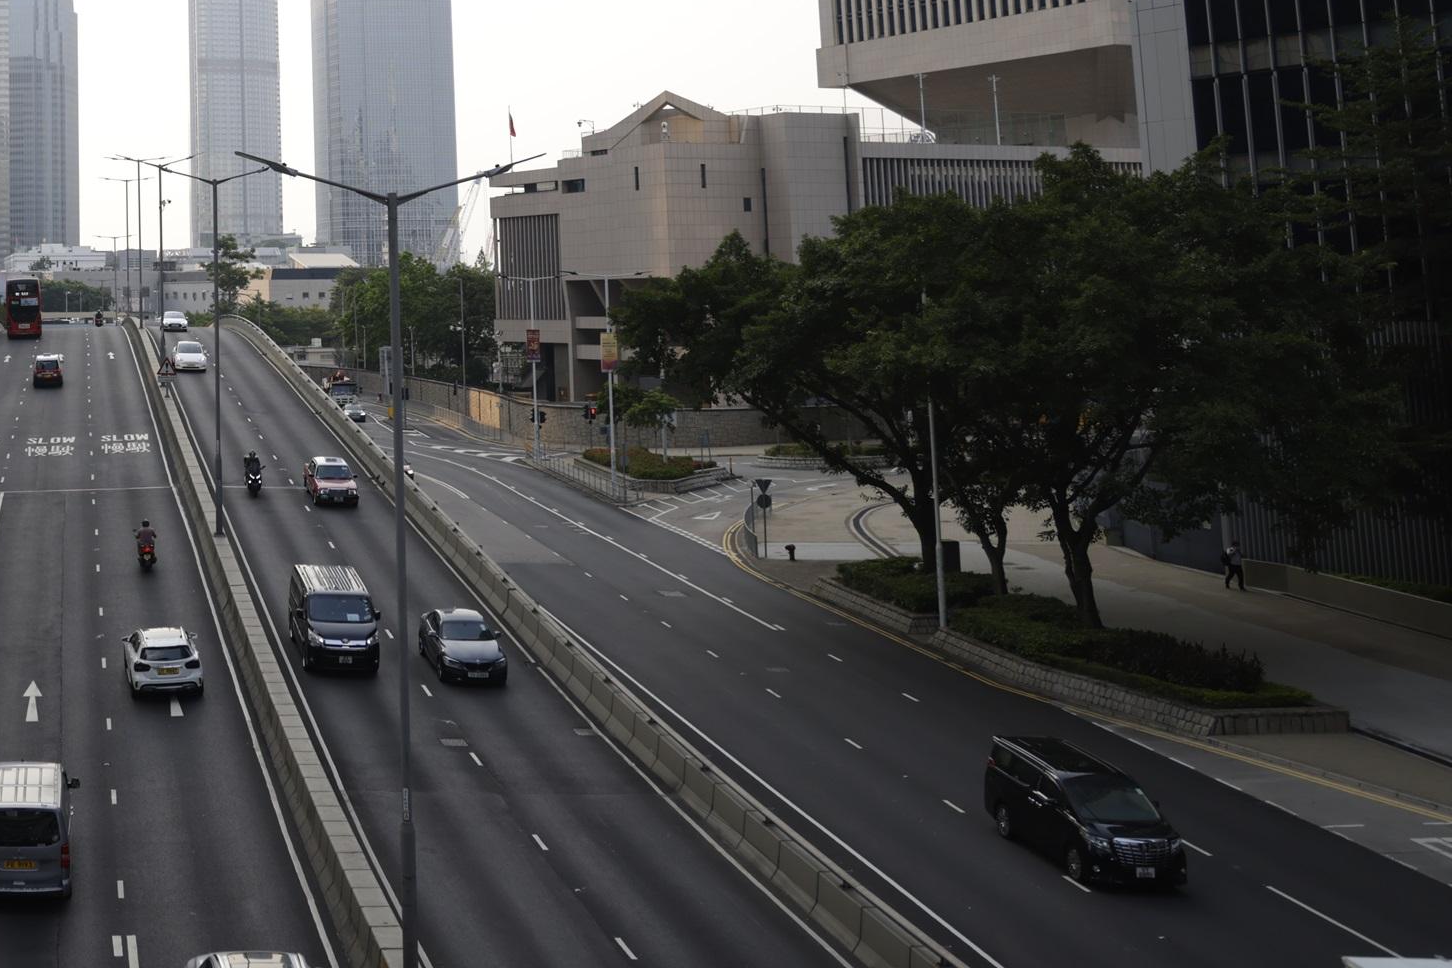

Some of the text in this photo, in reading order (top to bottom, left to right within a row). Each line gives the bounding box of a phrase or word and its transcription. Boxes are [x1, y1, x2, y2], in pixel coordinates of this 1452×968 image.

[26, 436, 75, 445] SLOW
[100, 433, 149, 442] SLOW
[24, 445, 74, 457] 慢駛
[100, 442, 150, 454] 慢駛
